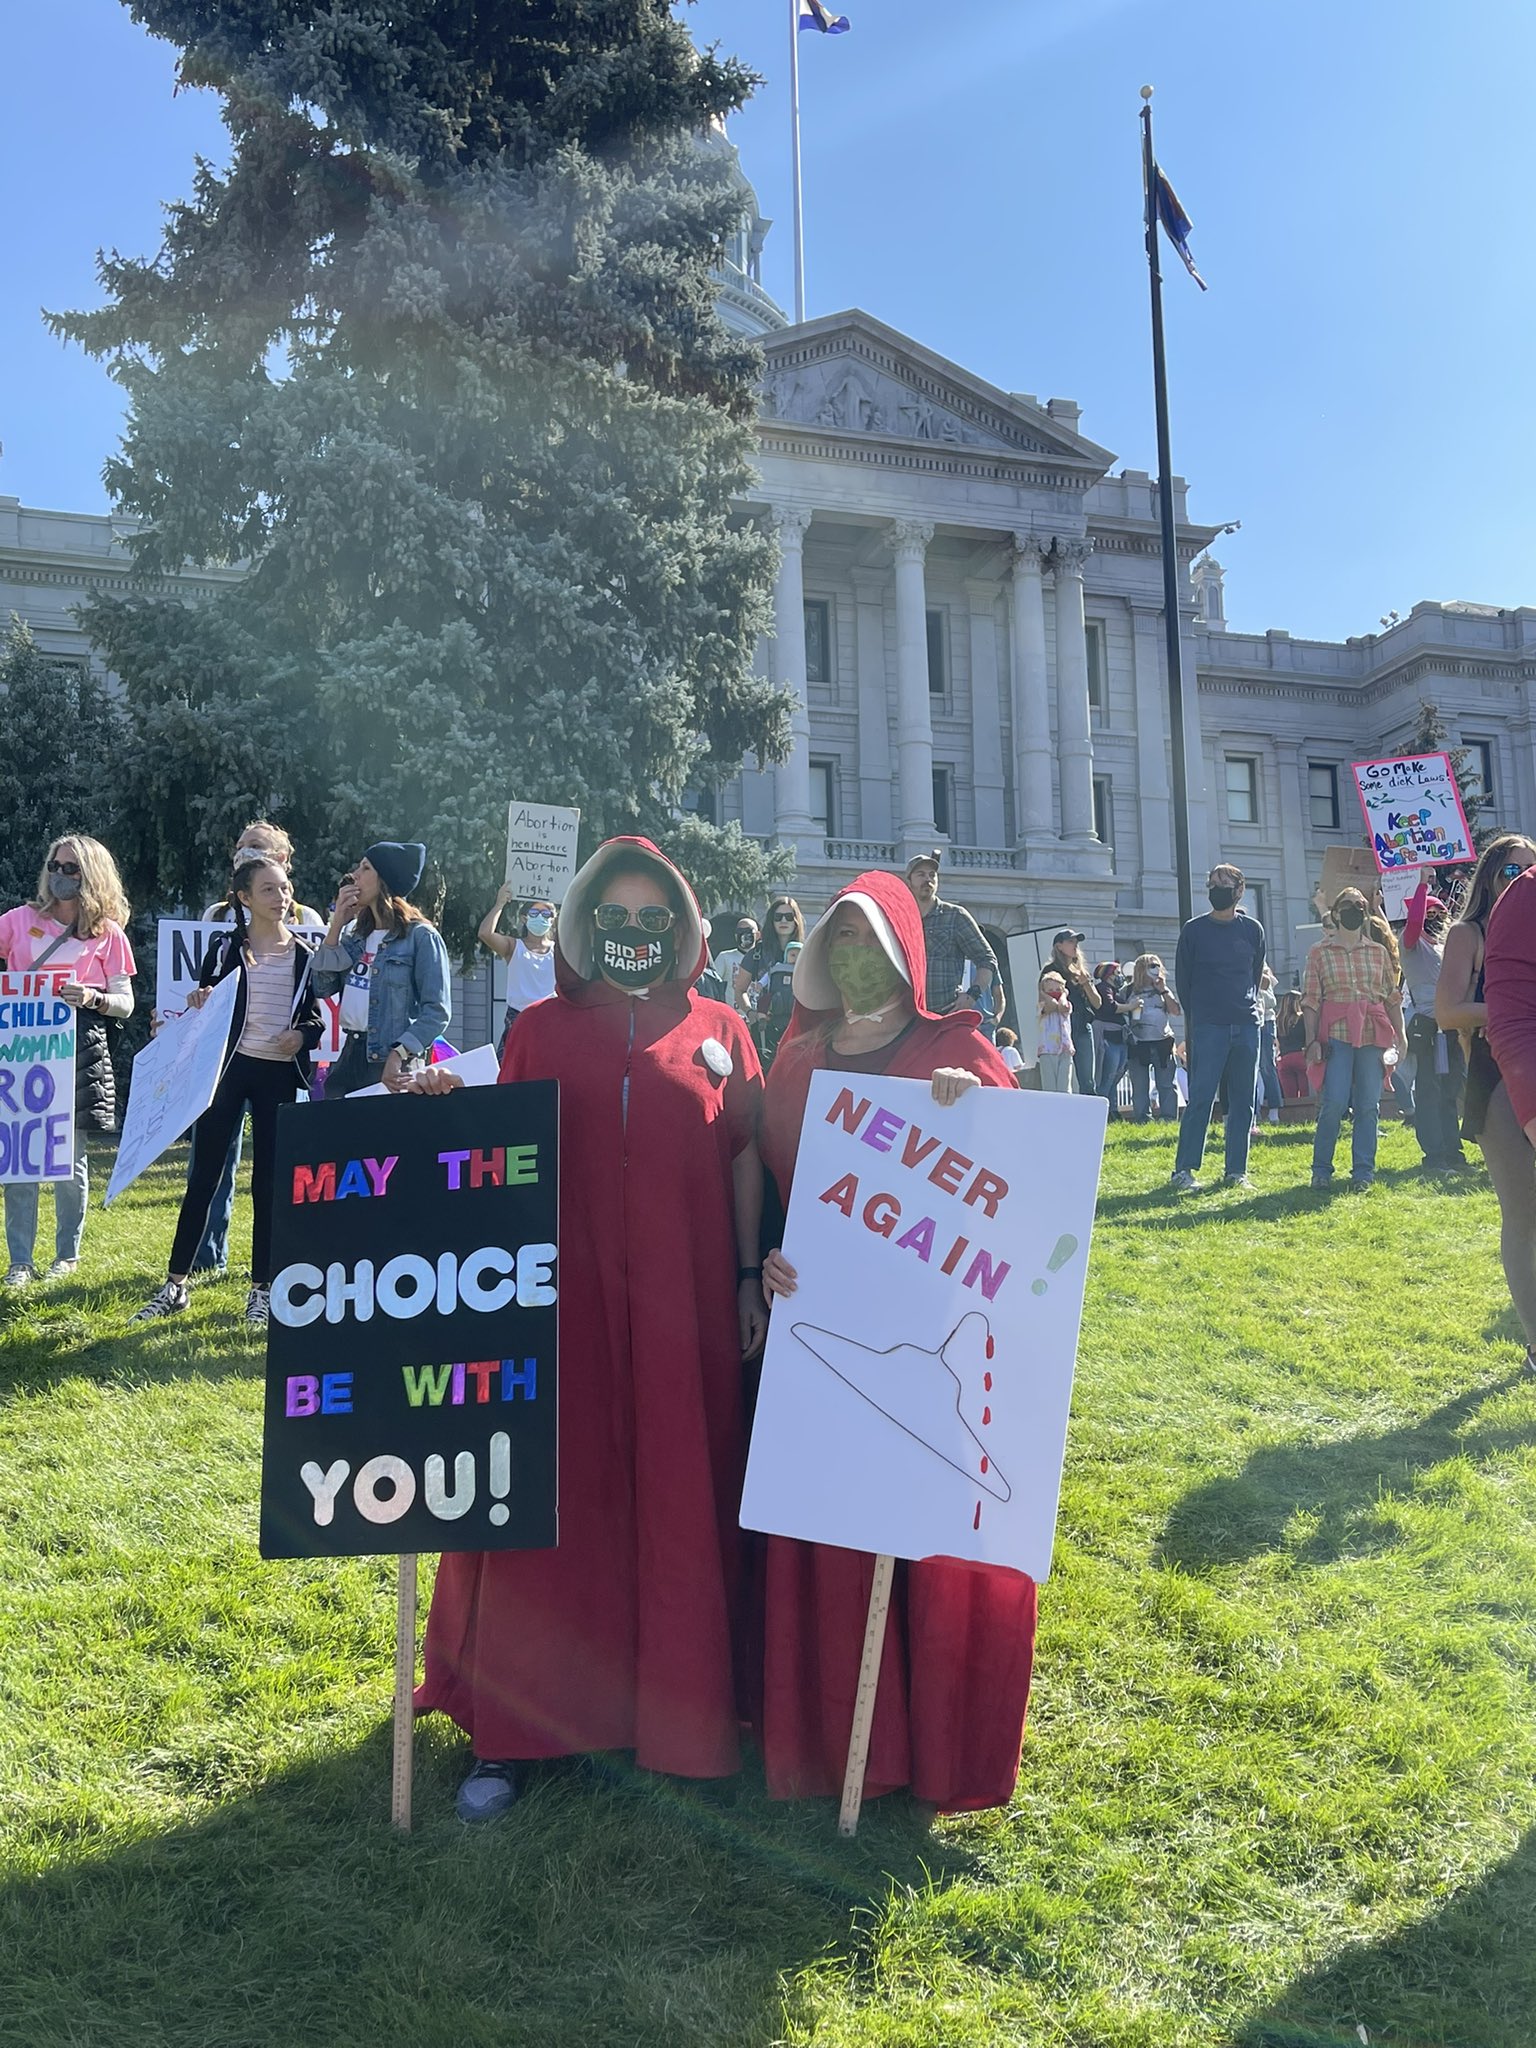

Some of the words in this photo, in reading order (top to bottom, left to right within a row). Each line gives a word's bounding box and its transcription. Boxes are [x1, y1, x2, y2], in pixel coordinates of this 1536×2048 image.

[514, 809, 576, 832] Abortion
[1375, 827, 1446, 851] Abortion
[512, 856, 569, 873] Abortion
[519, 884, 552, 897] right
[604, 940, 662, 960] BIDEN
[2, 973, 71, 997] LIFE
[0, 1002, 71, 1029] CHILD
[825, 1086, 1010, 1219] NEVER
[292, 1155, 400, 1204] MAY
[437, 1144, 539, 1191] THE
[269, 1242, 558, 1328] CHOICE
[285, 1372, 354, 1418] BE
[402, 1358, 537, 1407] WITH
[300, 1431, 511, 1527] YOU!
